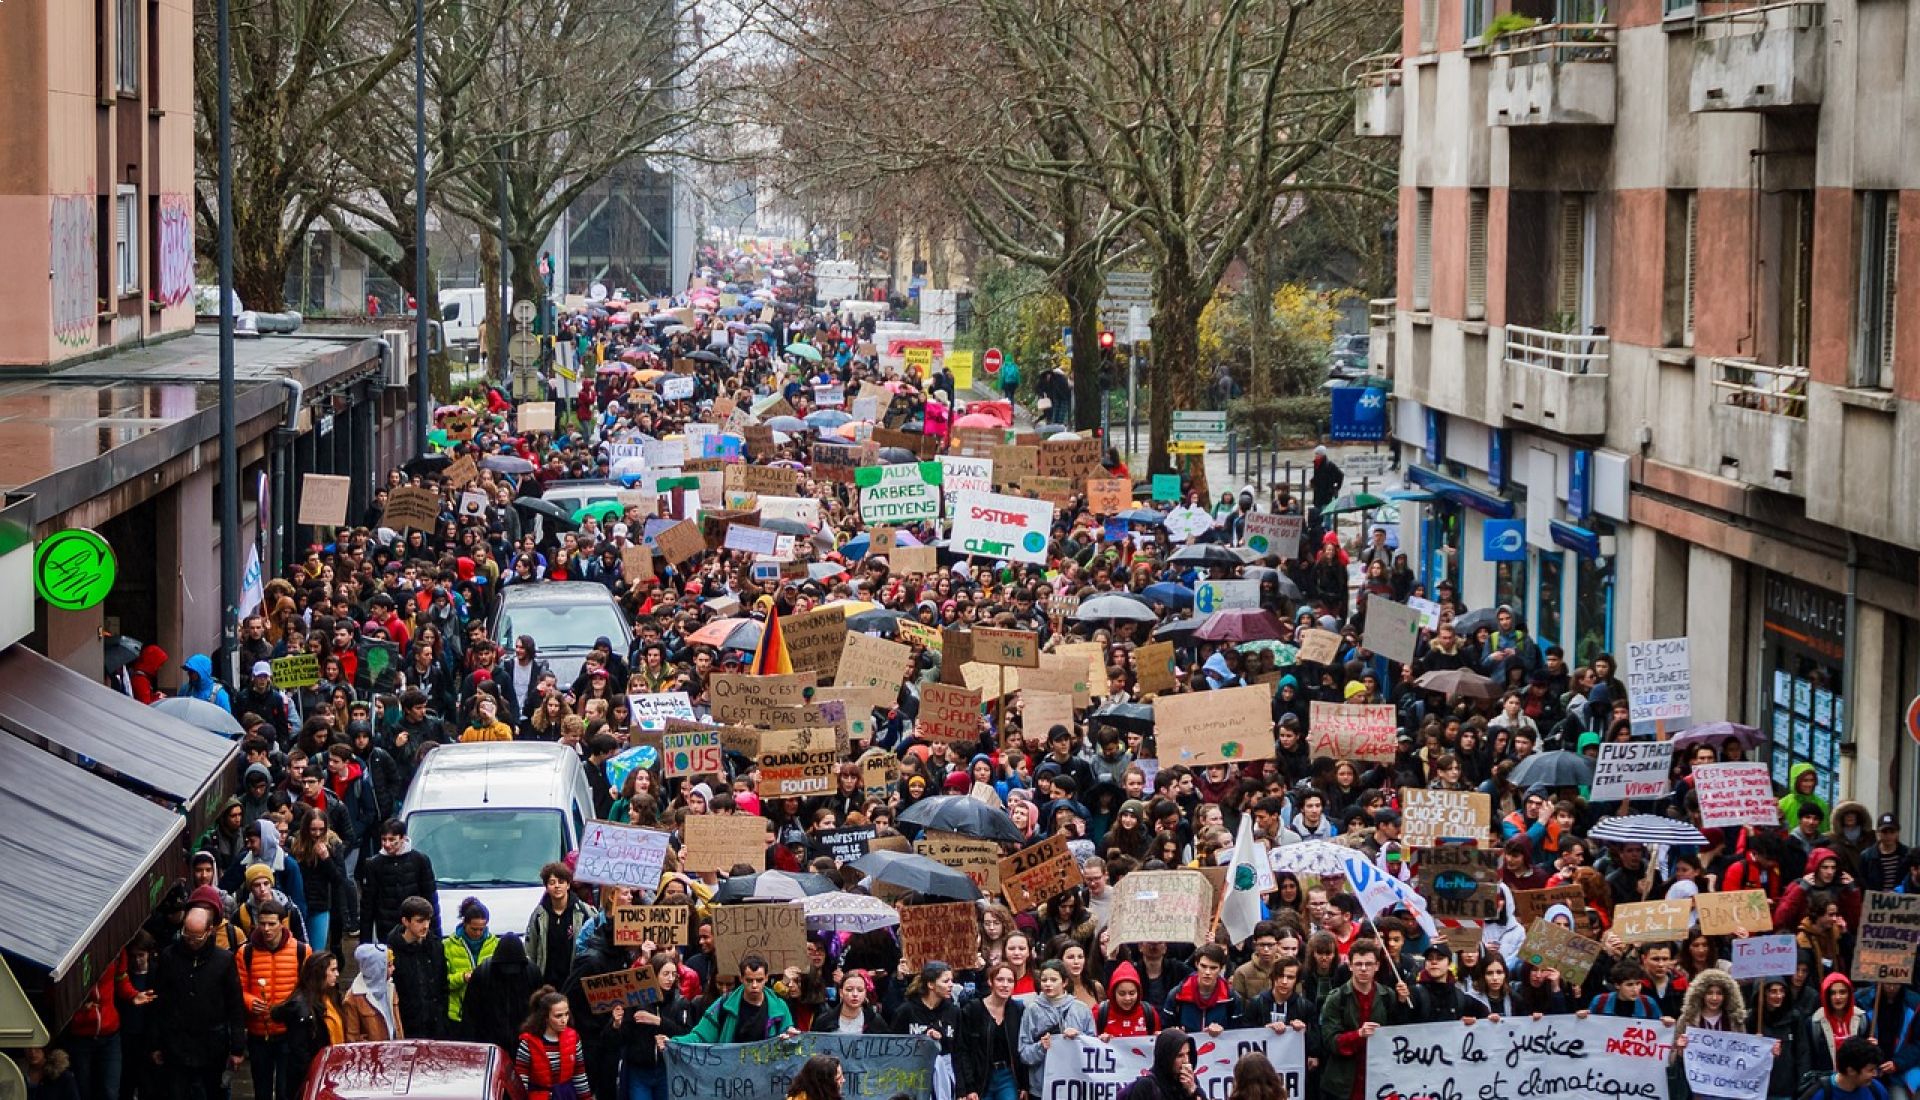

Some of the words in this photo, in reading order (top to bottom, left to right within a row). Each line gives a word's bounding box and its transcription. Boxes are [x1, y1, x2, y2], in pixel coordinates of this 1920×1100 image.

[883, 465, 917, 479] AUX
[869, 484, 925, 500] ARBRES
[862, 500, 937, 518] CITOYENS
[1248, 513, 1278, 527] CLIMATE
[1001, 644, 1023, 658] DIE
[1630, 643, 1653, 657] DIS
[1656, 641, 1686, 655] MON
[1634, 656, 1664, 671] FILS
[715, 680, 761, 698] QUAND
[769, 684, 798, 696] C'EST
[923, 688, 946, 704] ON
[634, 698, 652, 709] Ta
[720, 704, 752, 720] C'EST
[772, 711, 796, 724] PAS
[804, 711, 820, 723] DE
[665, 732, 718, 749] SAUVONS
[763, 752, 809, 767] QUAND
[810, 751, 836, 764] C'EST
[1601, 745, 1638, 760] PLUS
[1643, 743, 1671, 758] TARD
[665, 748, 719, 776] NOUS
[1597, 763, 1613, 774] JE
[1616, 760, 1669, 773] VOUDRAIS
[761, 766, 803, 780] FONDUE
[804, 764, 833, 777] C'EST
[1625, 781, 1665, 796] VIVANT
[1406, 790, 1425, 806] LA
[1425, 790, 1469, 810] SEULE
[1404, 806, 1446, 823] CHOSE
[1448, 809, 1477, 825] QUI
[1406, 821, 1437, 835] DOIT
[850, 844, 861, 853] LE
[1871, 893, 1917, 910] HAUT
[618, 908, 647, 923] TOUS
[648, 907, 672, 924] DANS
[674, 909, 687, 926] LA
[642, 927, 679, 946] MERDE
[746, 933, 770, 949] ON
[1879, 964, 1910, 978] BAIN
[1623, 1026, 1658, 1042] ZAP
[838, 1036, 925, 1060] VEILLESSE
[1391, 1035, 1454, 1067] Pour
[1461, 1031, 1489, 1063] la
[1505, 1024, 1588, 1069] justice
[1605, 1037, 1671, 1063] PARTOUT
[1082, 1047, 1116, 1075] ILS
[671, 1074, 699, 1098] ON
[713, 1076, 756, 1100] AURA
[770, 1074, 793, 1096] PA
[1478, 1071, 1511, 1100] et
[1517, 1066, 1661, 1100] climatique
